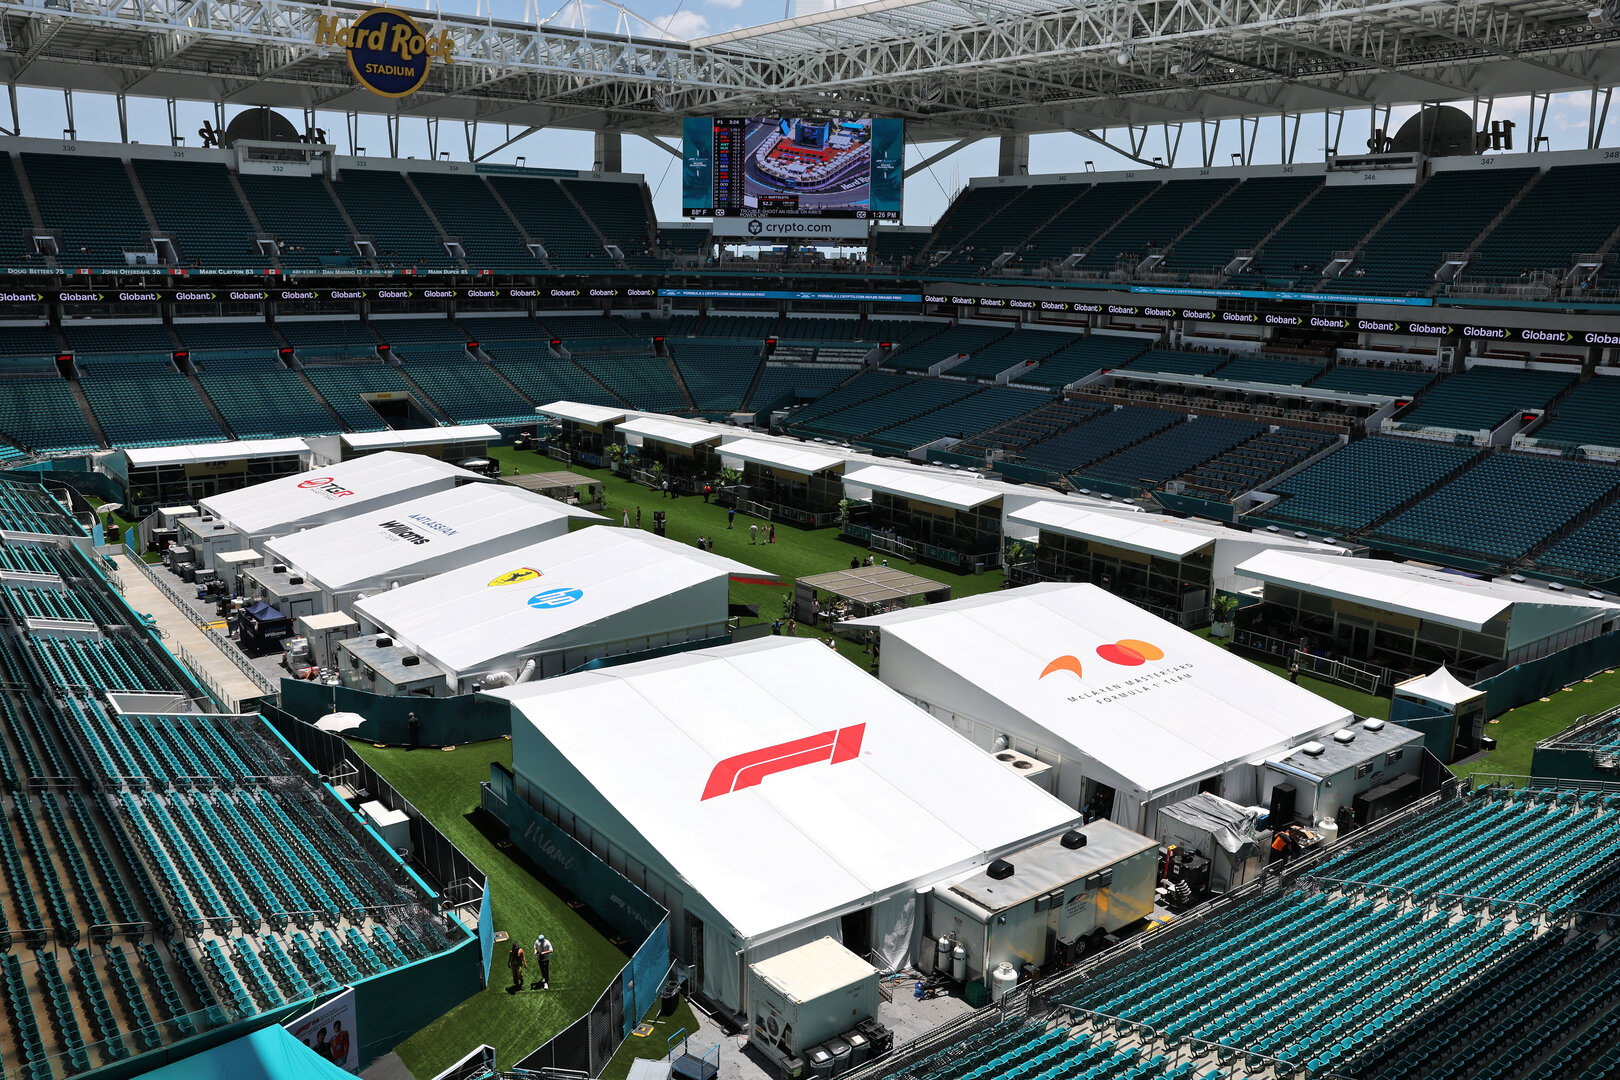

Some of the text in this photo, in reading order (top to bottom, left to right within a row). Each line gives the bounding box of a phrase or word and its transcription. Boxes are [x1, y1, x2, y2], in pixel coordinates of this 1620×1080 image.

[315, 15, 455, 64] Hard Rock
[366, 64, 414, 77] STADIUM
[766, 222, 832, 233] crypto.com
[60, 293, 98, 301] Globant
[1042, 302, 1064, 310] Globant
[1074, 304, 1098, 312] Globant
[1109, 306, 1134, 314] Globant
[1145, 308, 1172, 316] Globant
[1183, 310, 1211, 319] Globant
[1223, 313, 1252, 322] Globant
[1266, 315, 1297, 325] Globant
[1310, 318, 1343, 328] Globant
[1358, 321, 1393, 331] Globant
[1409, 324, 1447, 334] Globant
[1464, 327, 1503, 338] Globant
[1522, 330, 1565, 342] Globant
[1585, 333, 1620, 344] Globa
[320, 483, 354, 497] TGR
[378, 520, 430, 545] Williams
[1125, 662, 1194, 686] MASTERCARD
[1096, 687, 1150, 705] FORMULA
[1163, 673, 1192, 685] TEAM
[524, 820, 575, 870] Miami
